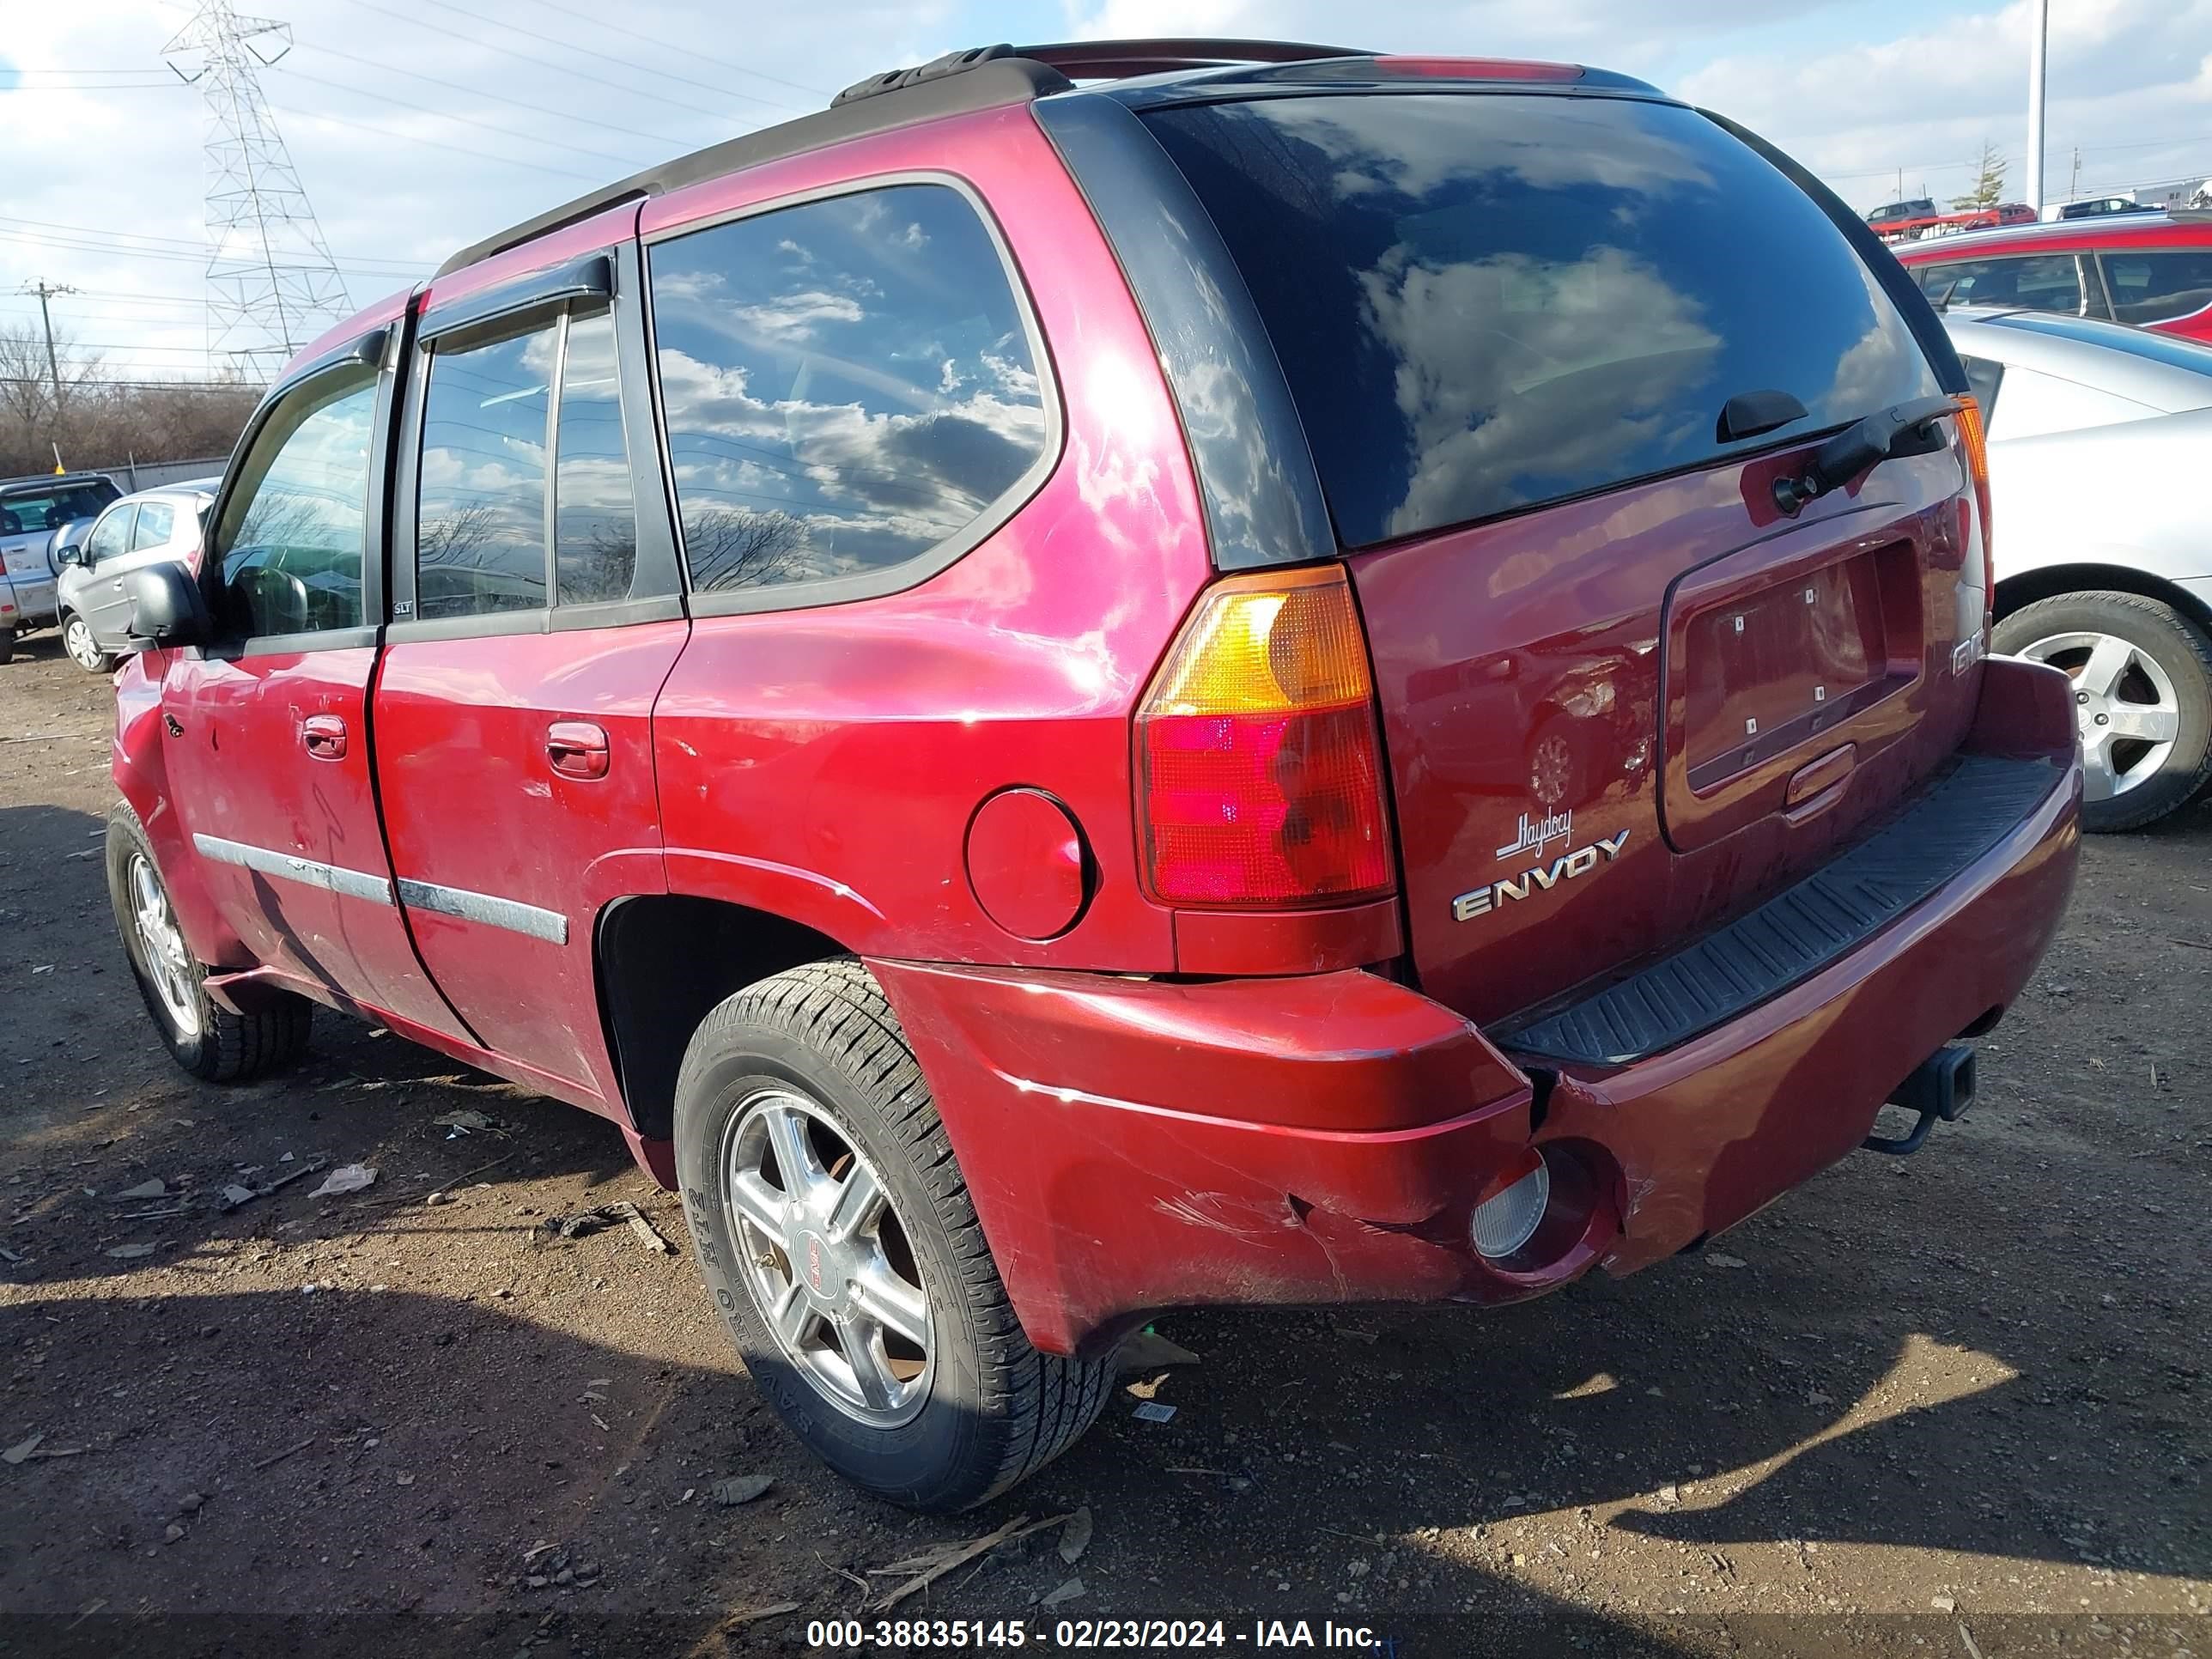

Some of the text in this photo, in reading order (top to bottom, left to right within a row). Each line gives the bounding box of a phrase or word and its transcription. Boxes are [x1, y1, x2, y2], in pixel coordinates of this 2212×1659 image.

[395, 603, 410, 614] SLT
[1451, 829, 1630, 921] ENVOY
[688, 1187, 720, 1269] HT2
[809, 1237, 821, 1291] GMC
